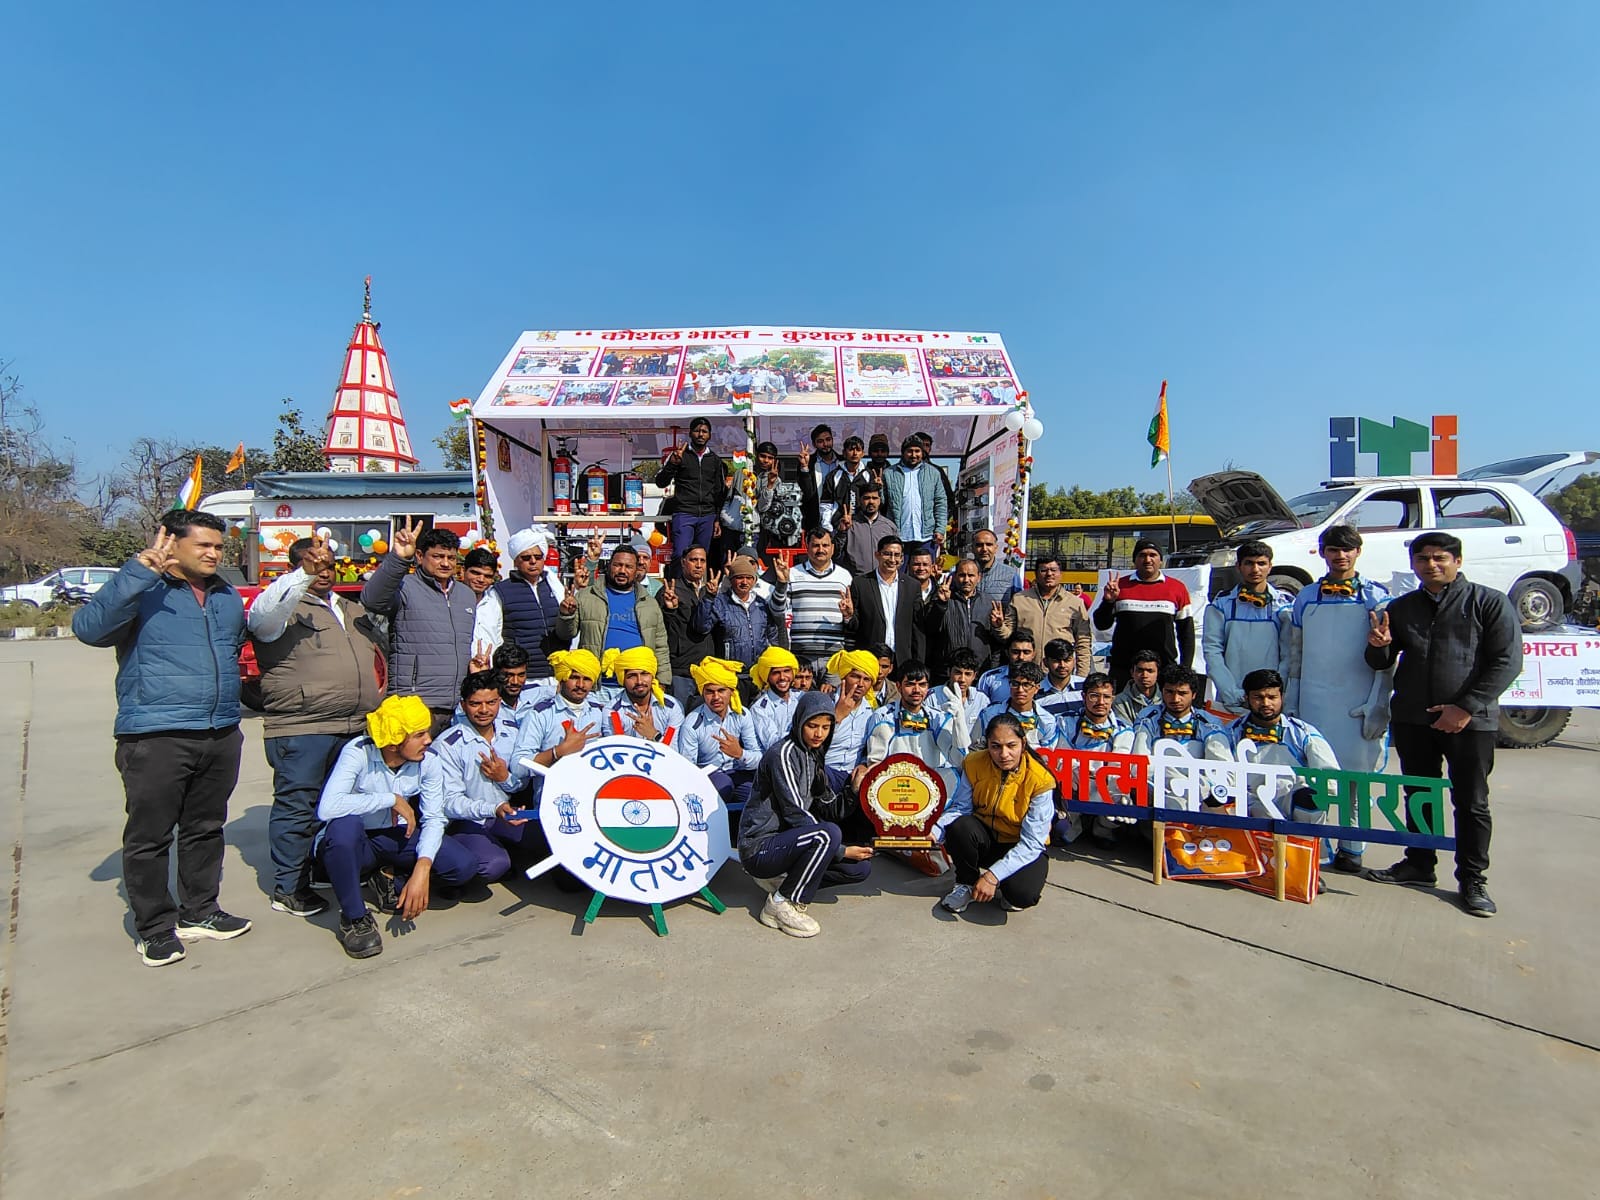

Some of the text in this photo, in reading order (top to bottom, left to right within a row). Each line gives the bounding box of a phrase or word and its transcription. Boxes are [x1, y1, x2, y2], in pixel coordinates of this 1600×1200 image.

[687, 330, 752, 341] भारत
[781, 330, 856, 344] कुशल
[862, 332, 924, 343] भारत
[580, 743, 665, 775] वन्दे
[1150, 738, 1297, 821] निर्भर
[1291, 766, 1454, 838] भारत
